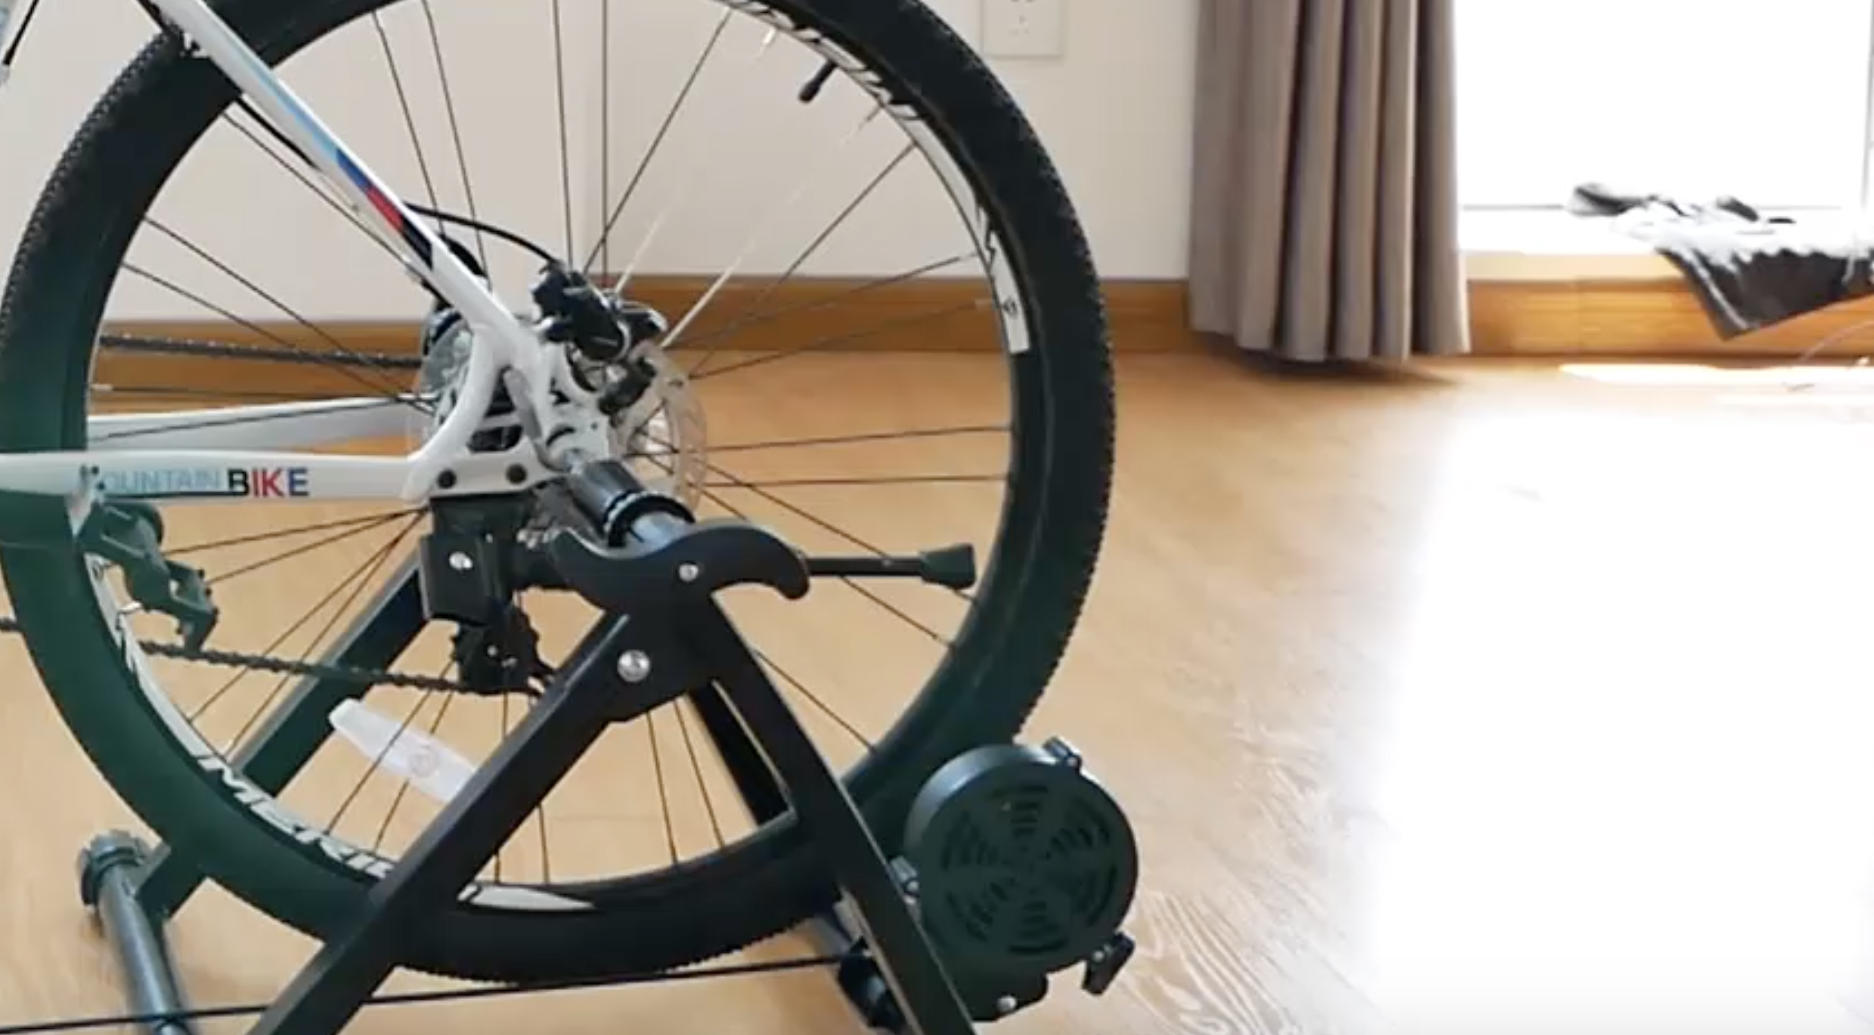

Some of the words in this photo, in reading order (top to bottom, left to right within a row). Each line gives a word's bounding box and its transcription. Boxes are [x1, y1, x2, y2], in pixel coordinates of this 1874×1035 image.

[96, 467, 221, 494] OUNTAIN
[227, 468, 310, 497] BIKE
[198, 754, 399, 882] MERI
